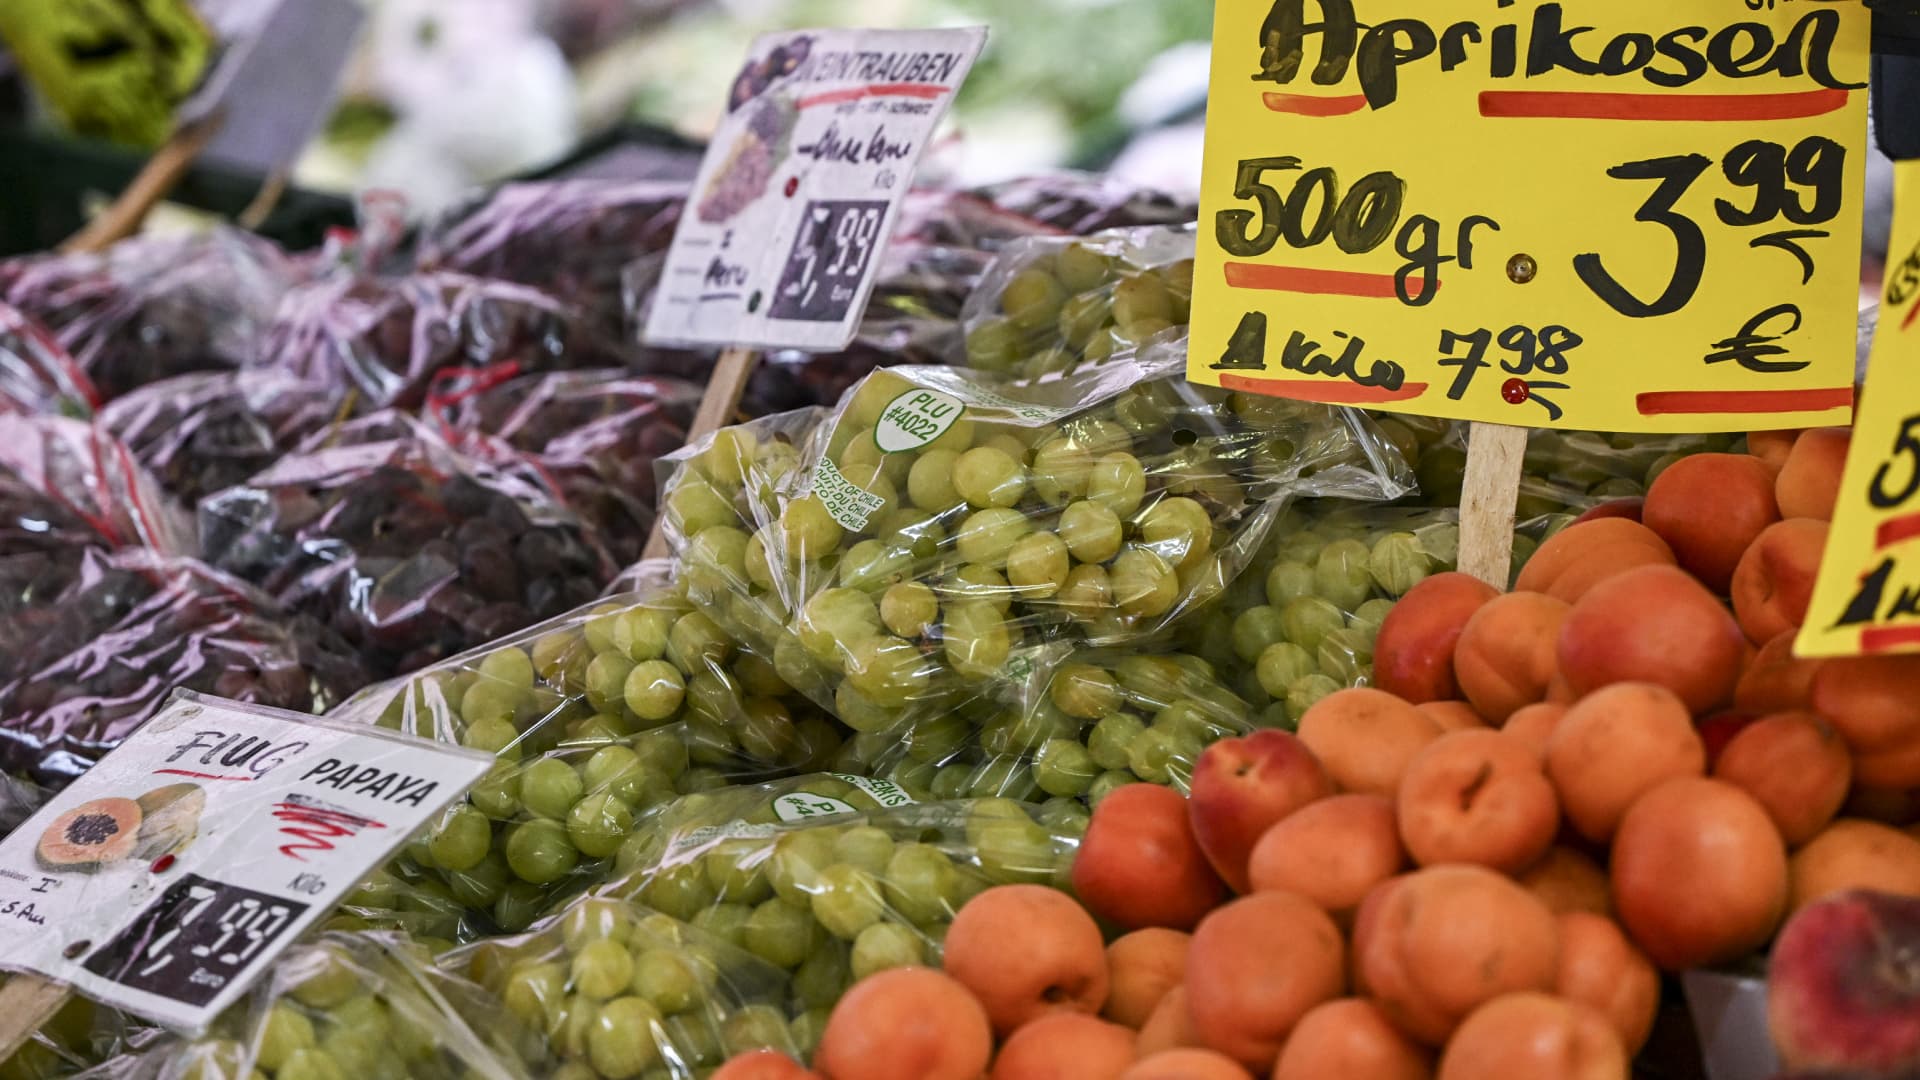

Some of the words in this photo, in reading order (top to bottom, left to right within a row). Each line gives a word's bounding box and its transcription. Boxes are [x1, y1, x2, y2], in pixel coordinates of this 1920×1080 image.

[1250, 0, 1868, 109] Aprikosen
[883, 405, 938, 441] #4022
[908, 392, 954, 419] PLU
[299, 757, 439, 807] PAPAYA
[287, 872, 327, 895] Kilo
[140, 885, 290, 977] 7,99
